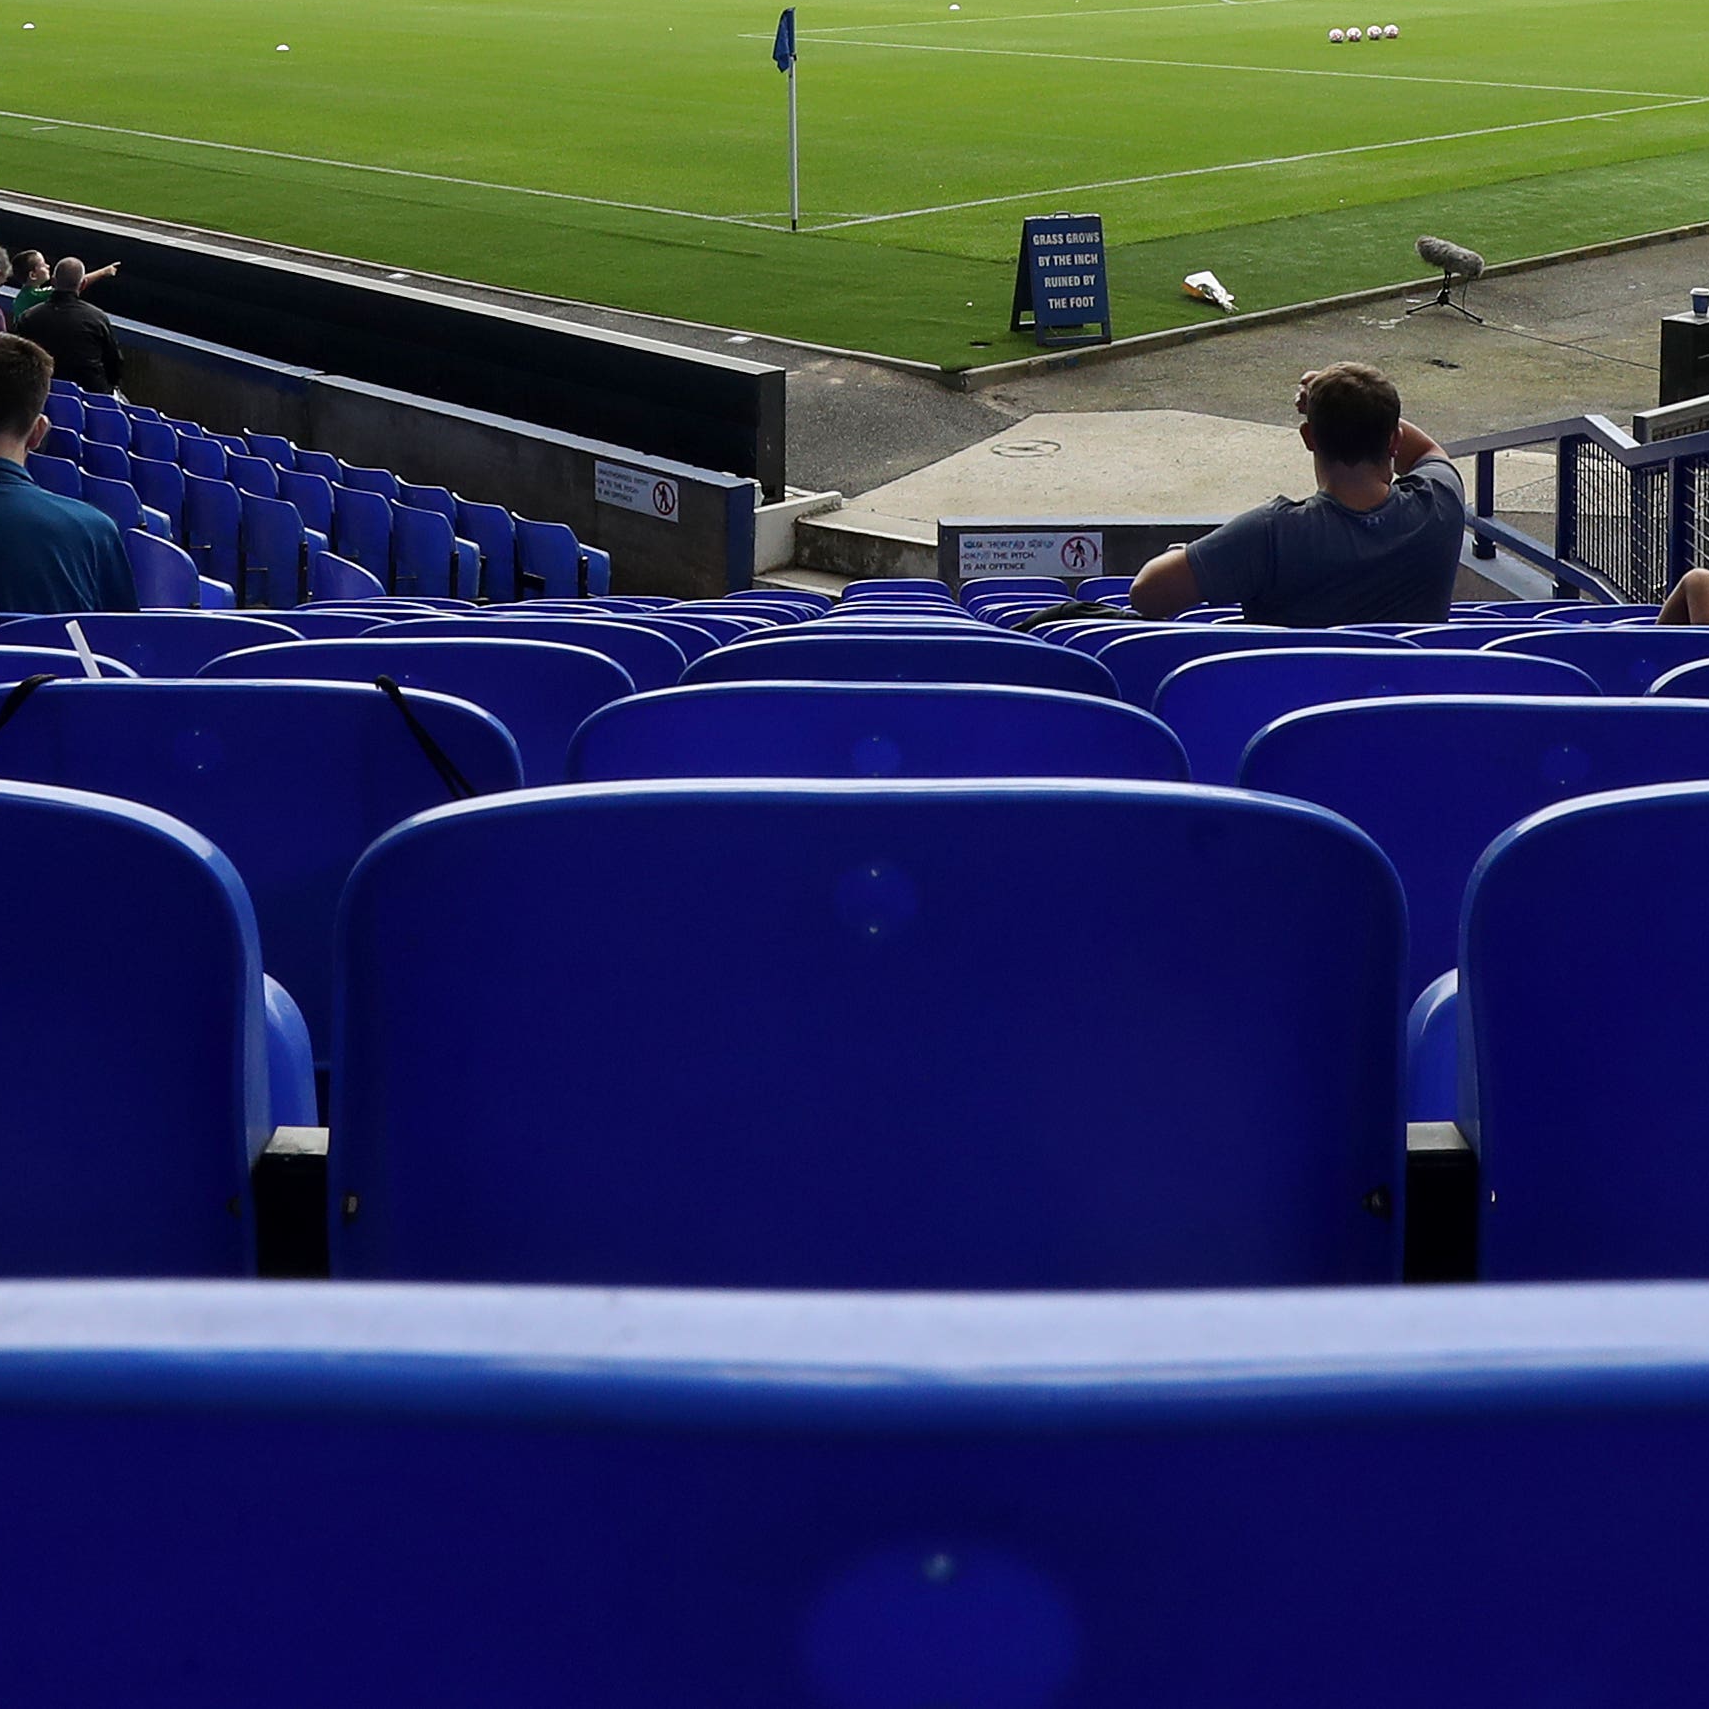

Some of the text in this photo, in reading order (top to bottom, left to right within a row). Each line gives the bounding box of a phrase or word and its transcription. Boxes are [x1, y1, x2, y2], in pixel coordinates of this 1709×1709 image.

[1032, 232, 1100, 245] GRASS GROWS
[1038, 253, 1099, 267] BY THE INCH
[1044, 274, 1096, 288] RUINED BY
[1048, 296, 1095, 309] THE FOOT
